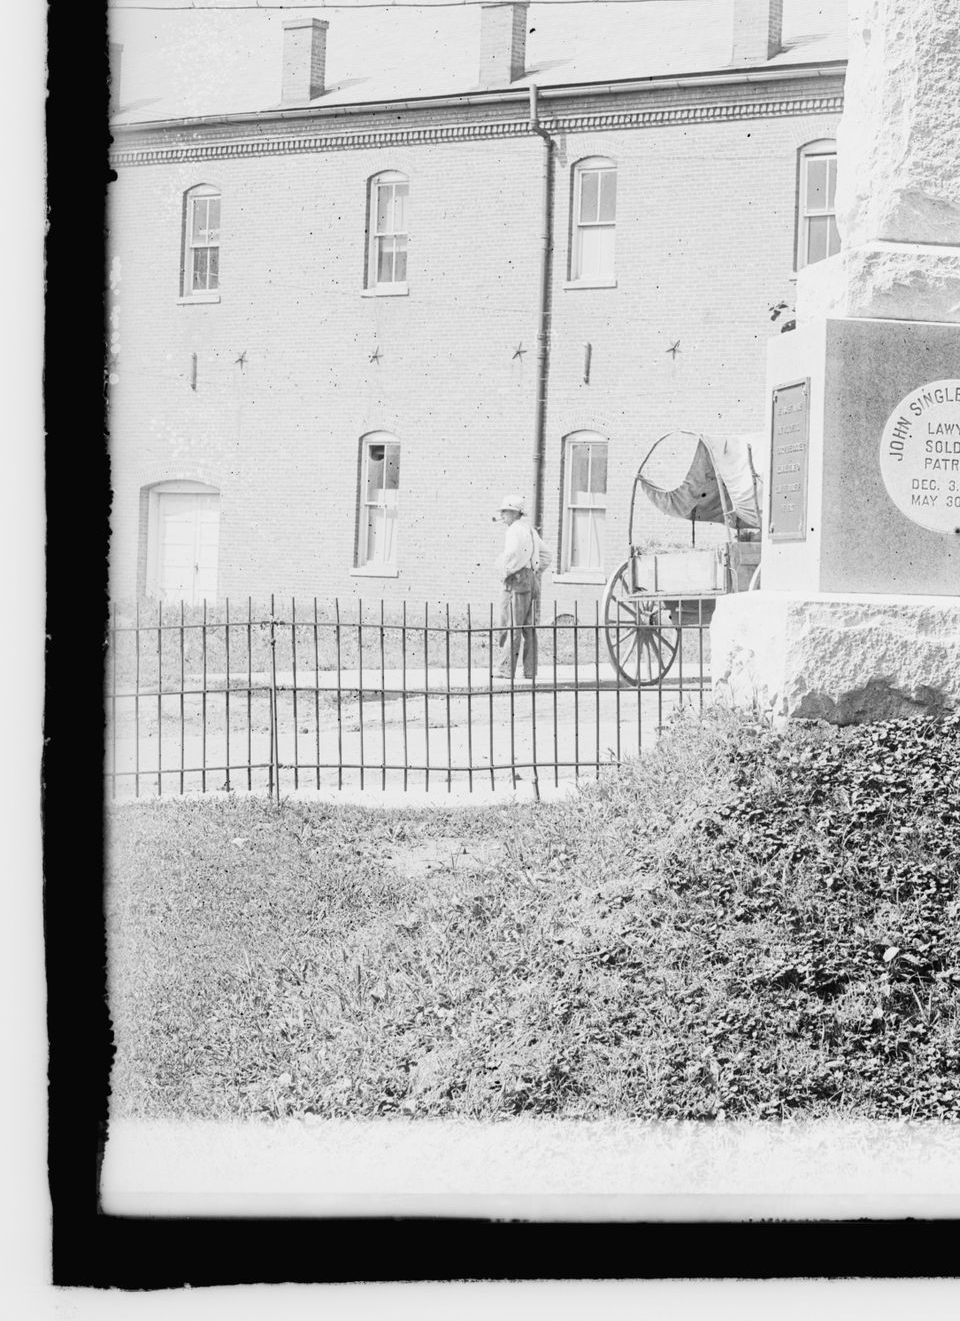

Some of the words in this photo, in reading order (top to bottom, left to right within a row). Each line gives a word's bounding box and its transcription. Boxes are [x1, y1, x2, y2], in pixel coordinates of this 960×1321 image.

[889, 416, 913, 462] JOHN
[911, 478, 941, 491] DEC.
[911, 494, 938, 507] MAY
